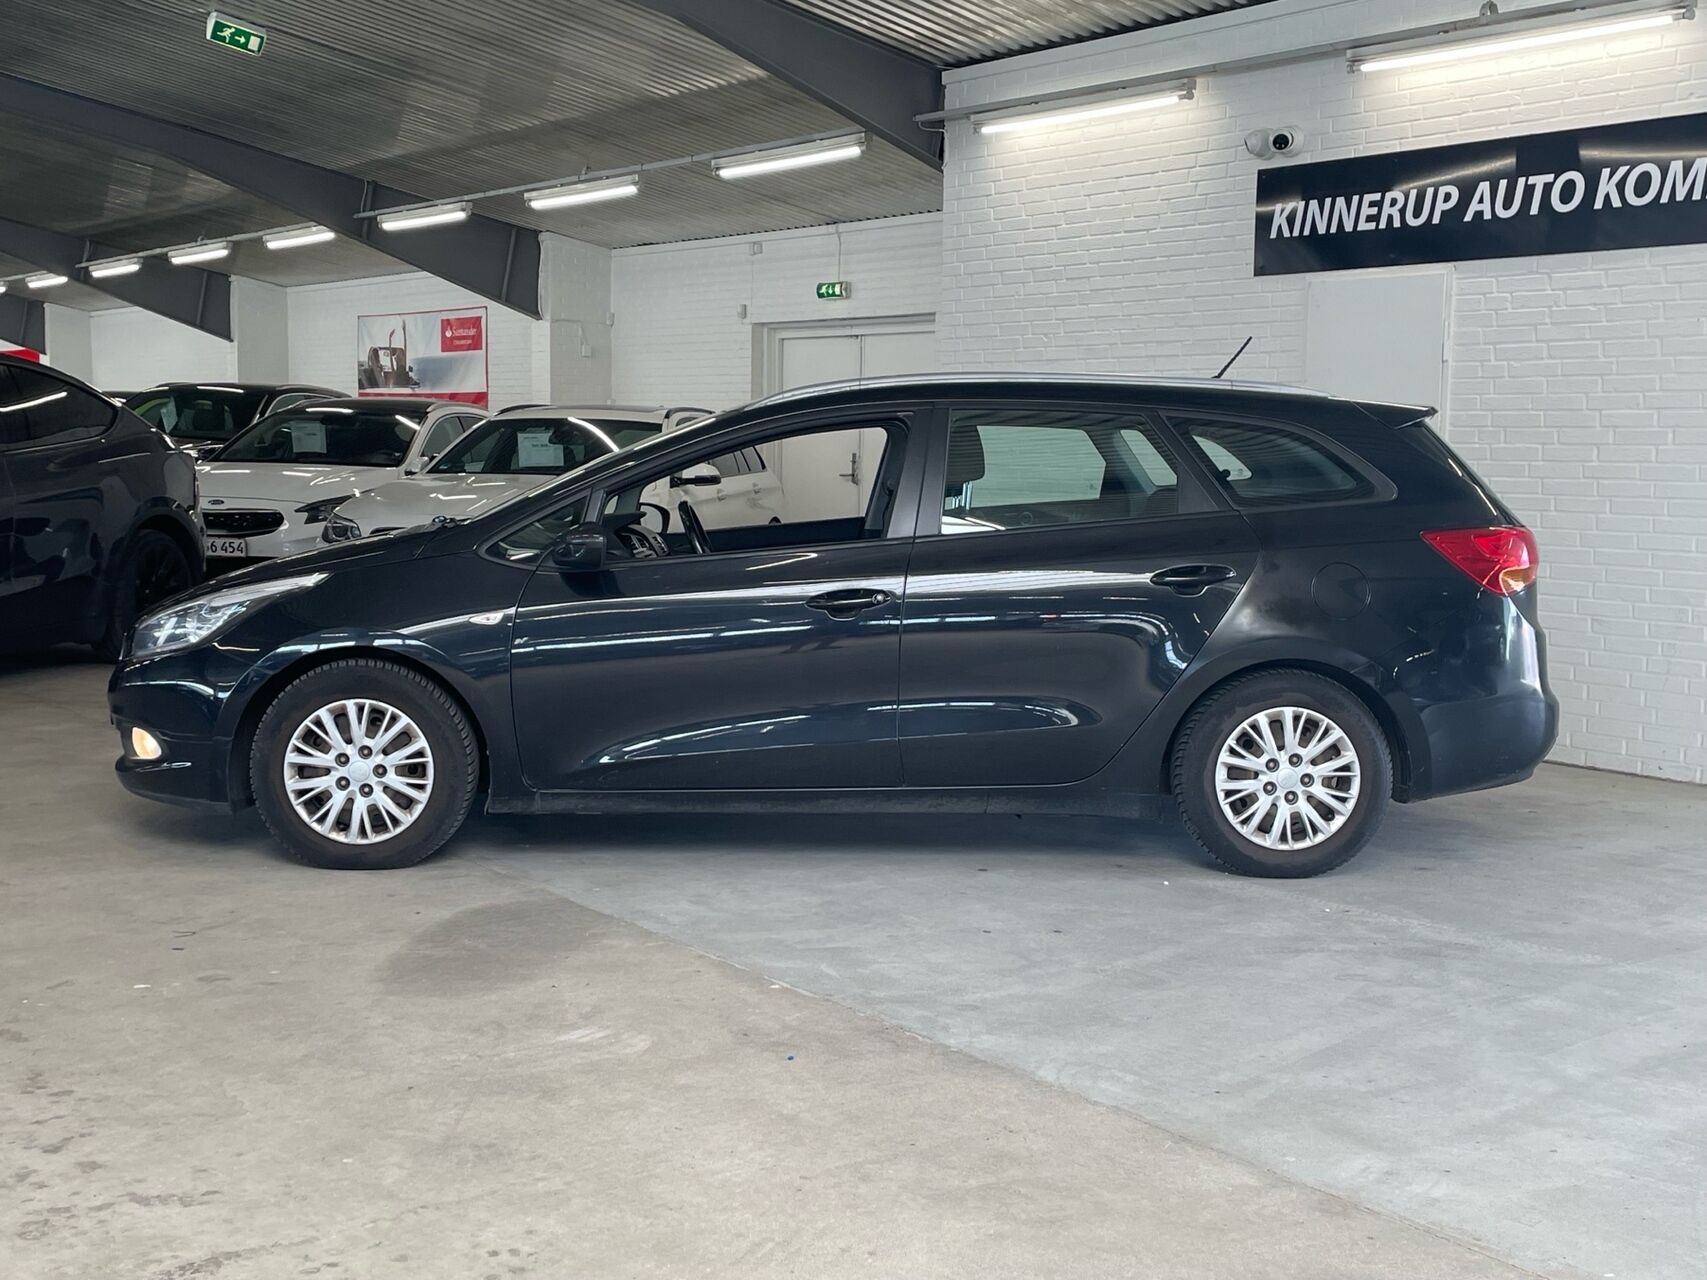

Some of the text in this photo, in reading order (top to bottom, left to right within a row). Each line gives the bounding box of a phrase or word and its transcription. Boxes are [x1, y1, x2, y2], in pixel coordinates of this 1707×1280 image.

[1269, 156, 1707, 239] KINNERUP AUTO KOM
[207, 540, 244, 554] 6 454
